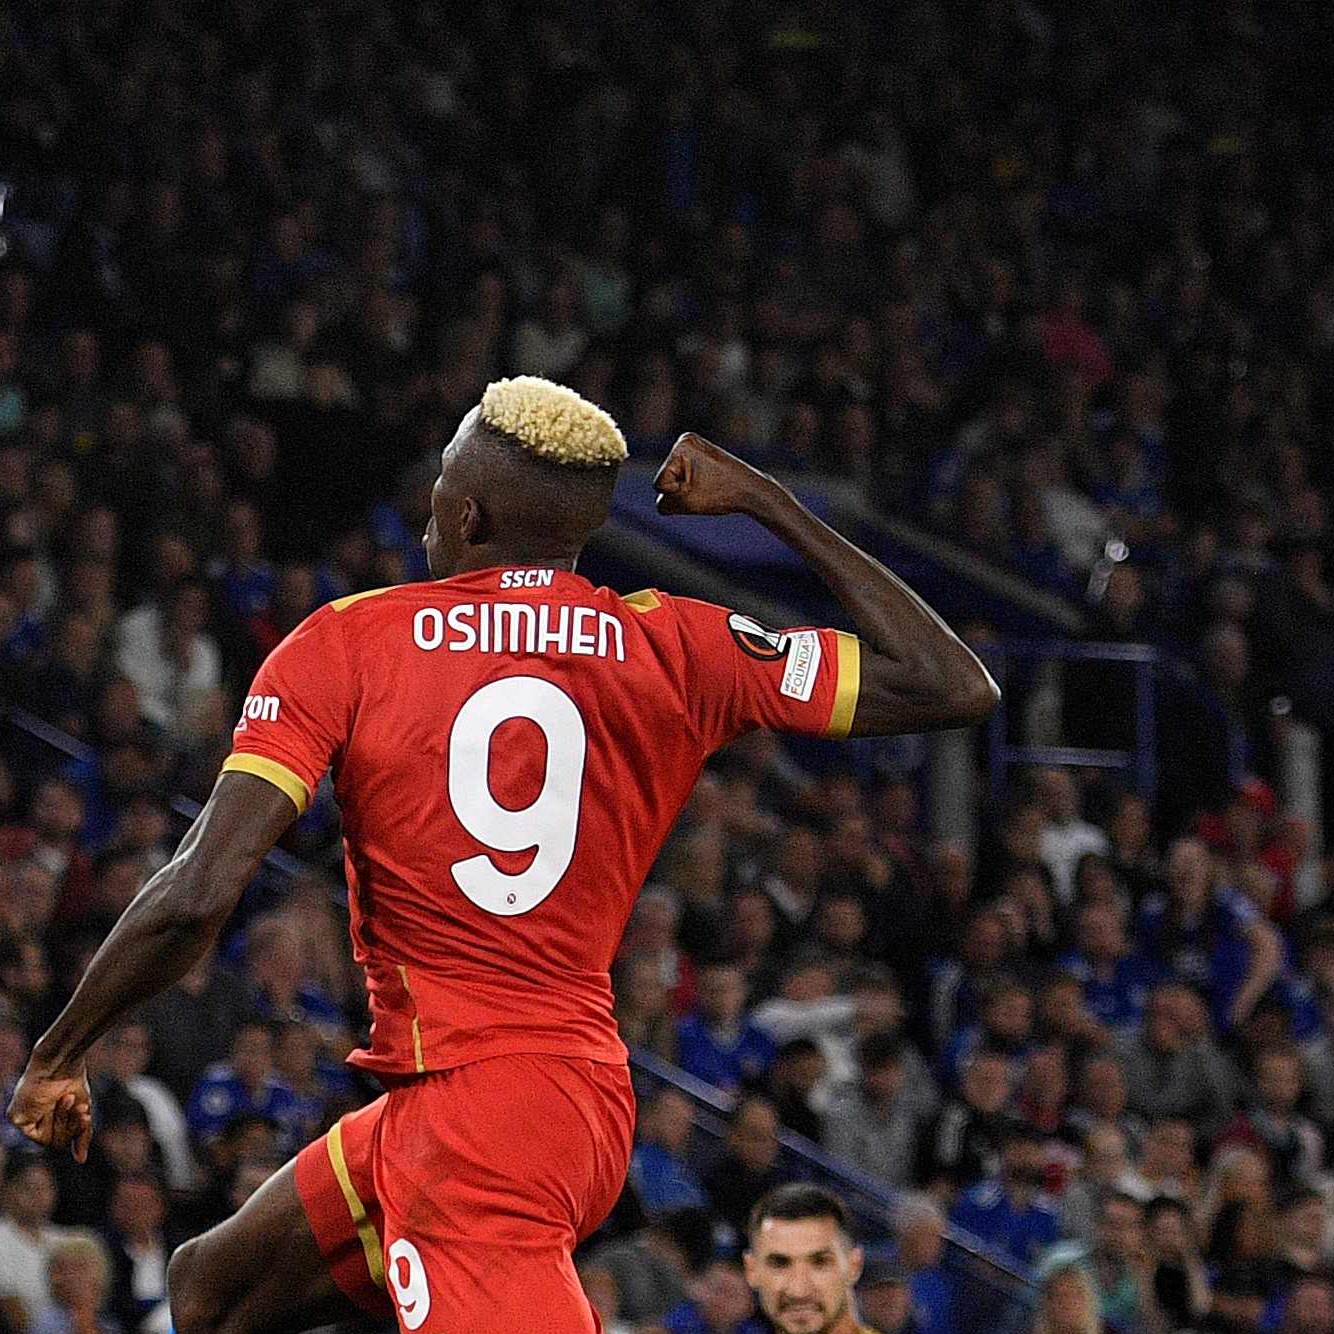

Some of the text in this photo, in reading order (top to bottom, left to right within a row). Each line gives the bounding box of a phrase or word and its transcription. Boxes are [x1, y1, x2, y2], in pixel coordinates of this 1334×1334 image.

[499, 569, 554, 588] SSCN
[413, 603, 625, 661] OSIMHEN
[448, 675, 587, 915] 9
[388, 1238, 430, 1330] 9
